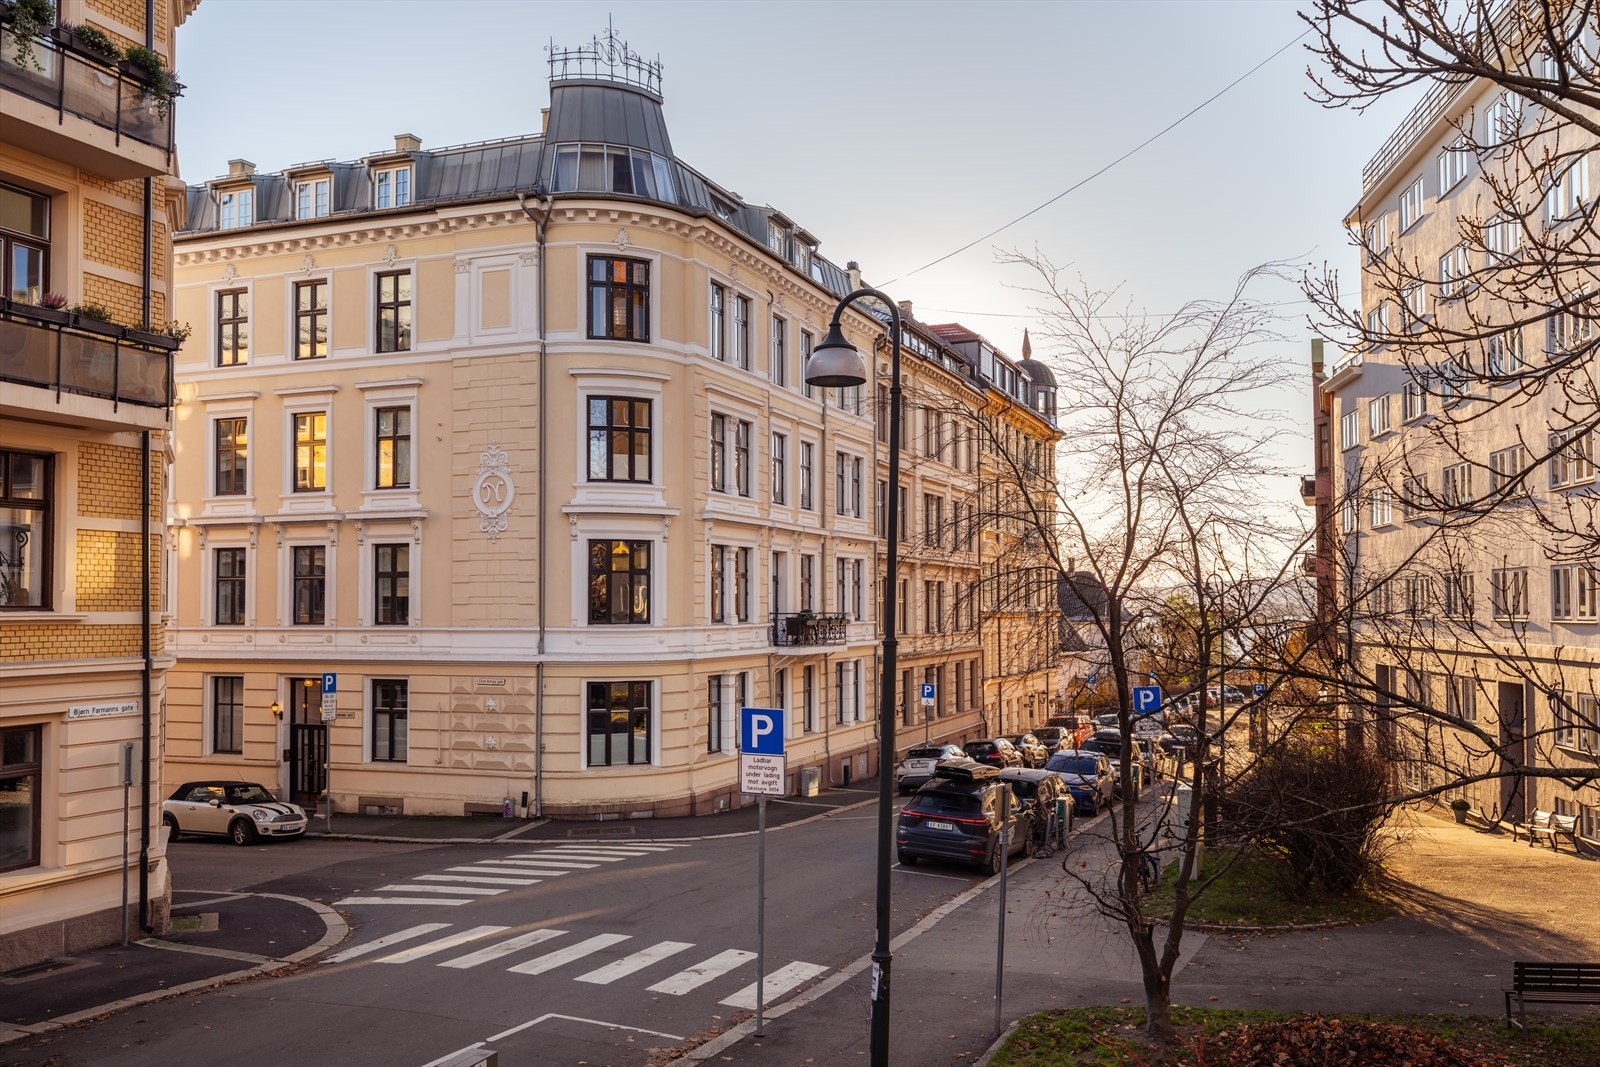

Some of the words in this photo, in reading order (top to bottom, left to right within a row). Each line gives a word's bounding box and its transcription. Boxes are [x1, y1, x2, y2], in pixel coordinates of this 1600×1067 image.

[326, 675, 334, 691] P
[924, 685, 932, 696] P
[1139, 690, 1154, 711] P
[73, 708, 90, 717] Bjørn
[91, 706, 119, 714] Farmanns
[121, 705, 134, 713] gate
[751, 714, 774, 748] P
